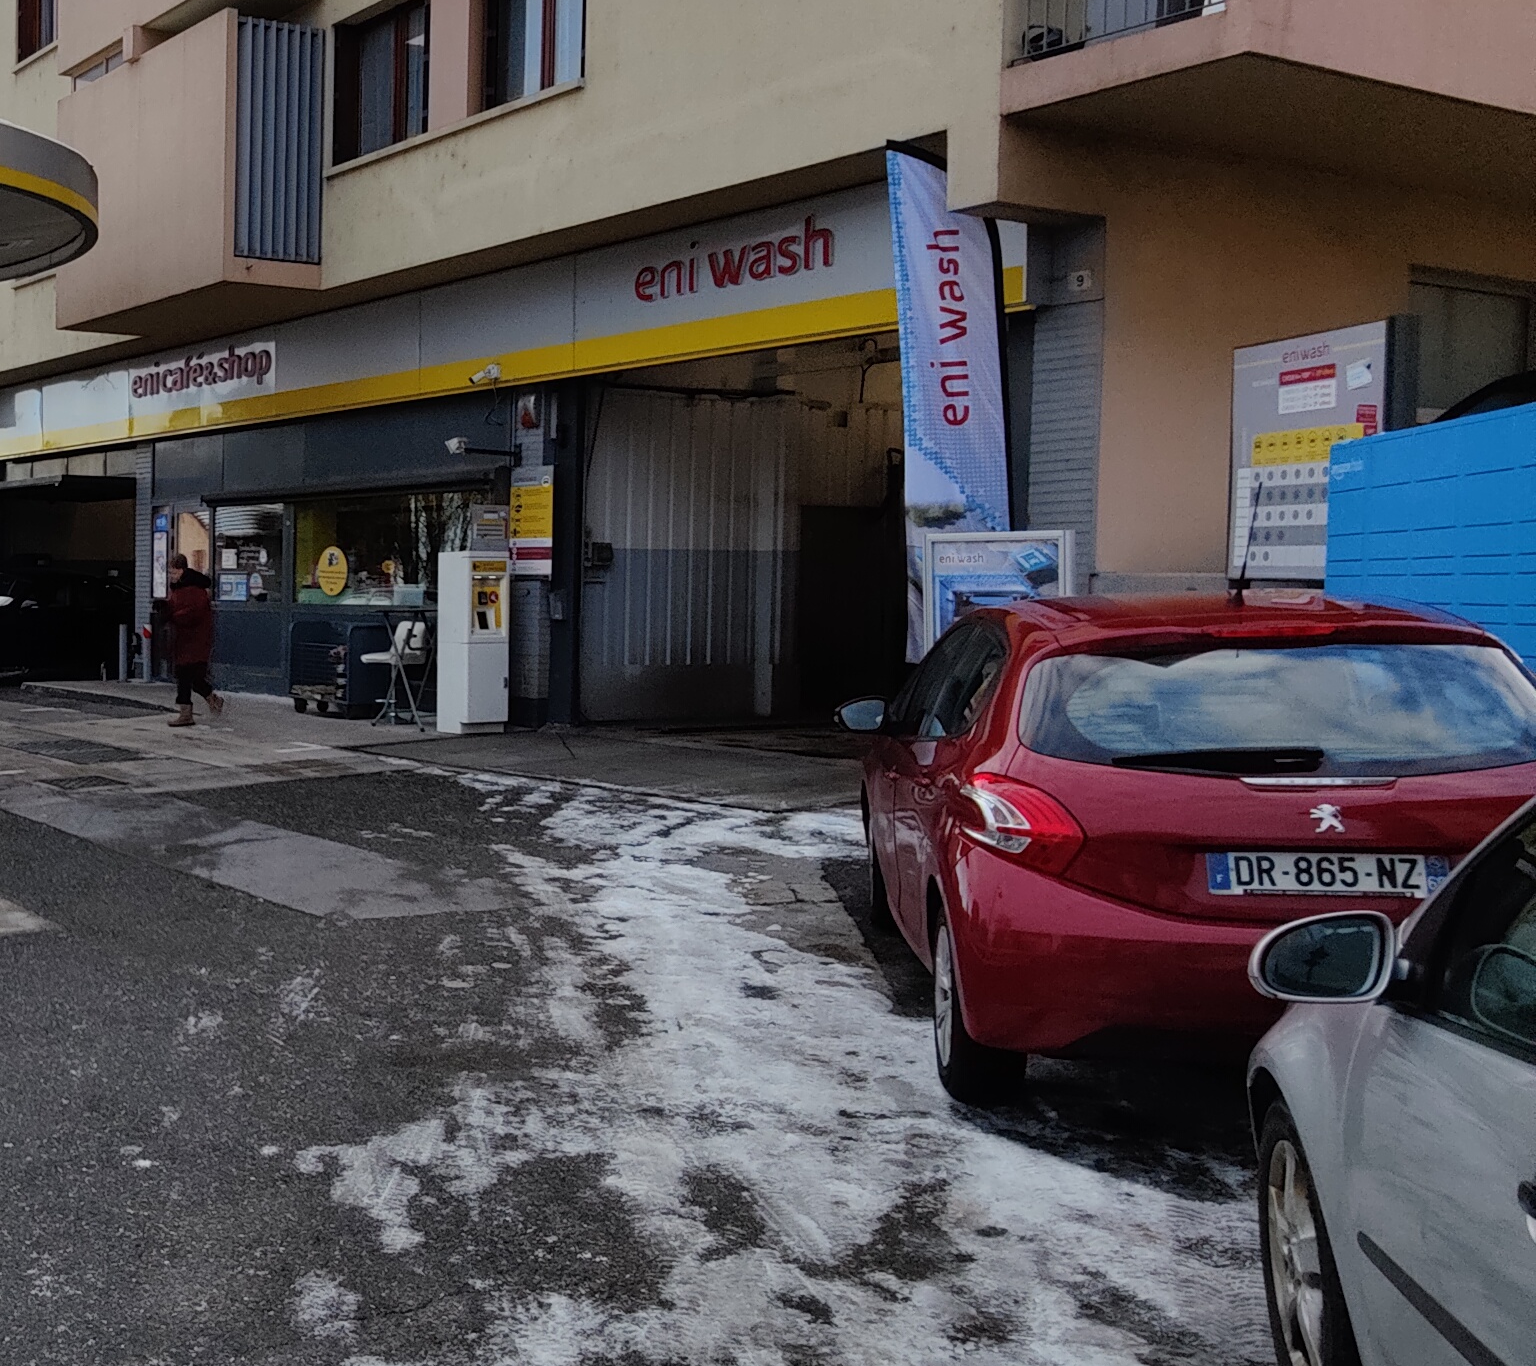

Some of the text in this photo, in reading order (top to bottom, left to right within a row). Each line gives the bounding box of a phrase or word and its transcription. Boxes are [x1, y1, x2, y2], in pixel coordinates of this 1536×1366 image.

[634, 213, 834, 302] eni wash
[1076, 274, 1084, 287] 9
[926, 229, 969, 426] eni wash
[131, 361, 160, 398] eni
[939, 552, 984, 564] eni wash
